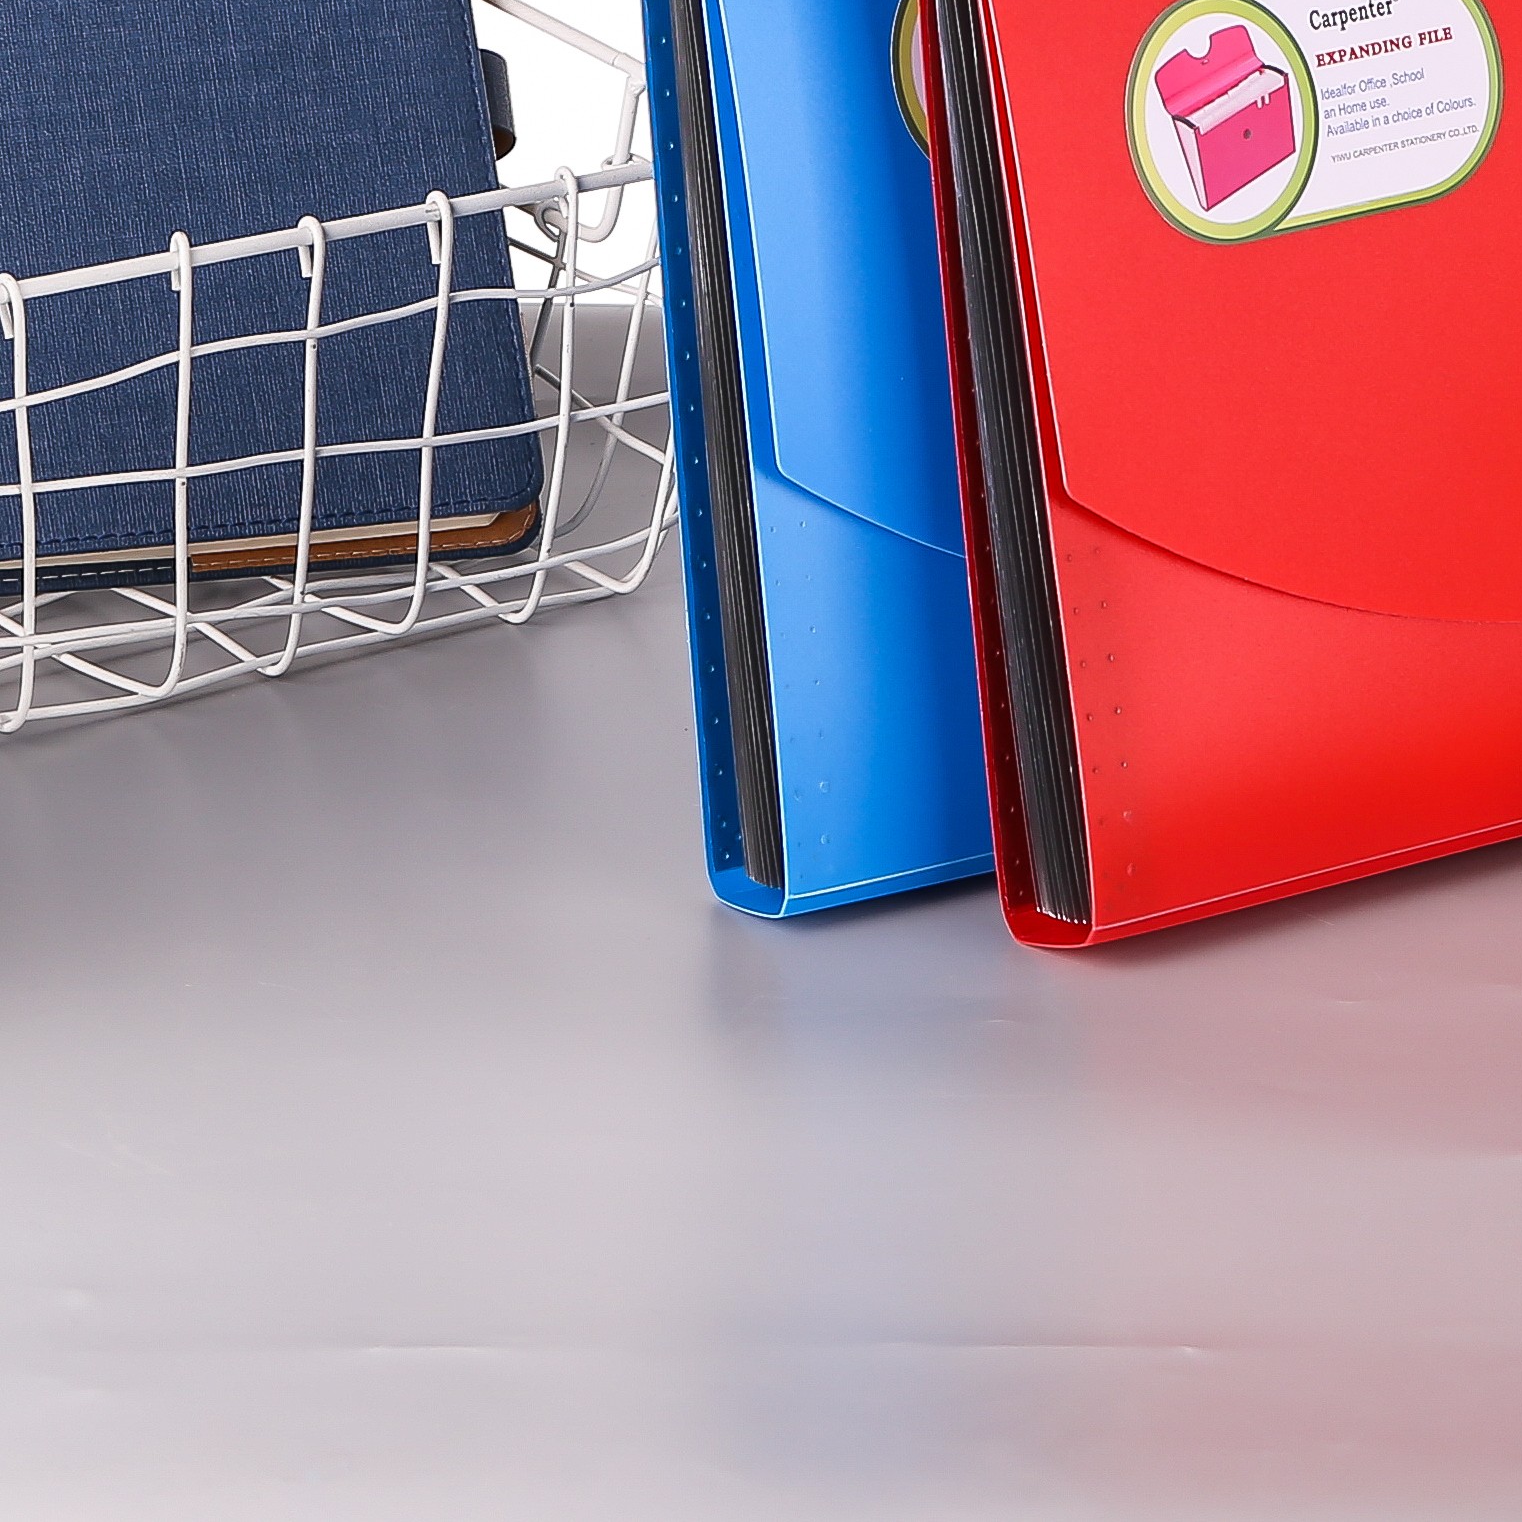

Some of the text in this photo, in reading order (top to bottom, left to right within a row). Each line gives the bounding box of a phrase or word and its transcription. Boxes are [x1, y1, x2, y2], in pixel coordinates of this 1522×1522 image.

[1315, 27, 1453, 68] EXPANDING FILE
[1359, 77, 1386, 92] Office
[1324, 107, 1337, 119] an
[1338, 101, 1367, 117] Home
[1326, 117, 1370, 137] Available
[1371, 114, 1381, 127] in
[1383, 114, 1390, 125] a
[1391, 106, 1423, 123] choice
[1425, 102, 1435, 115] of
[1353, 141, 1400, 158] CARPENTER
